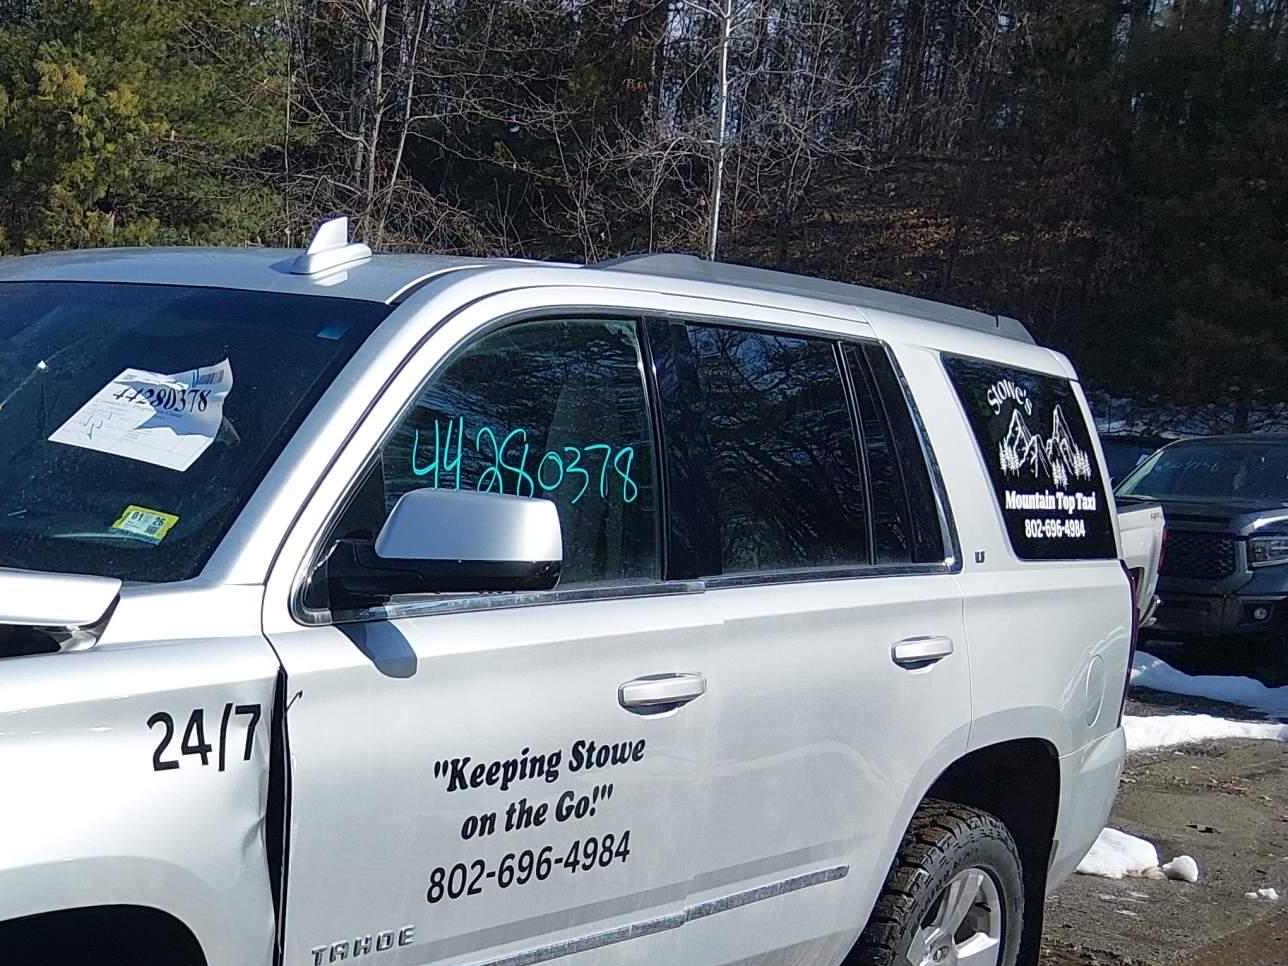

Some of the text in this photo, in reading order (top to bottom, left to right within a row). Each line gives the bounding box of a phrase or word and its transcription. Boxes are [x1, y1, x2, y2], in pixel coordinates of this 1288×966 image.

[112, 386, 212, 413] 44280378
[986, 377, 1033, 417] Stowe's
[412, 416, 638, 503] 44280378
[131, 511, 166, 527] 01 26
[1005, 490, 1097, 515] Mountain Top Taxi
[1025, 519, 1086, 538] 802-696-4984
[146, 702, 262, 772] 24/7
[434, 737, 646, 793] "Keeping Stowe
[461, 783, 615, 841] on the Go!"
[426, 830, 631, 904] 802-696-4984
